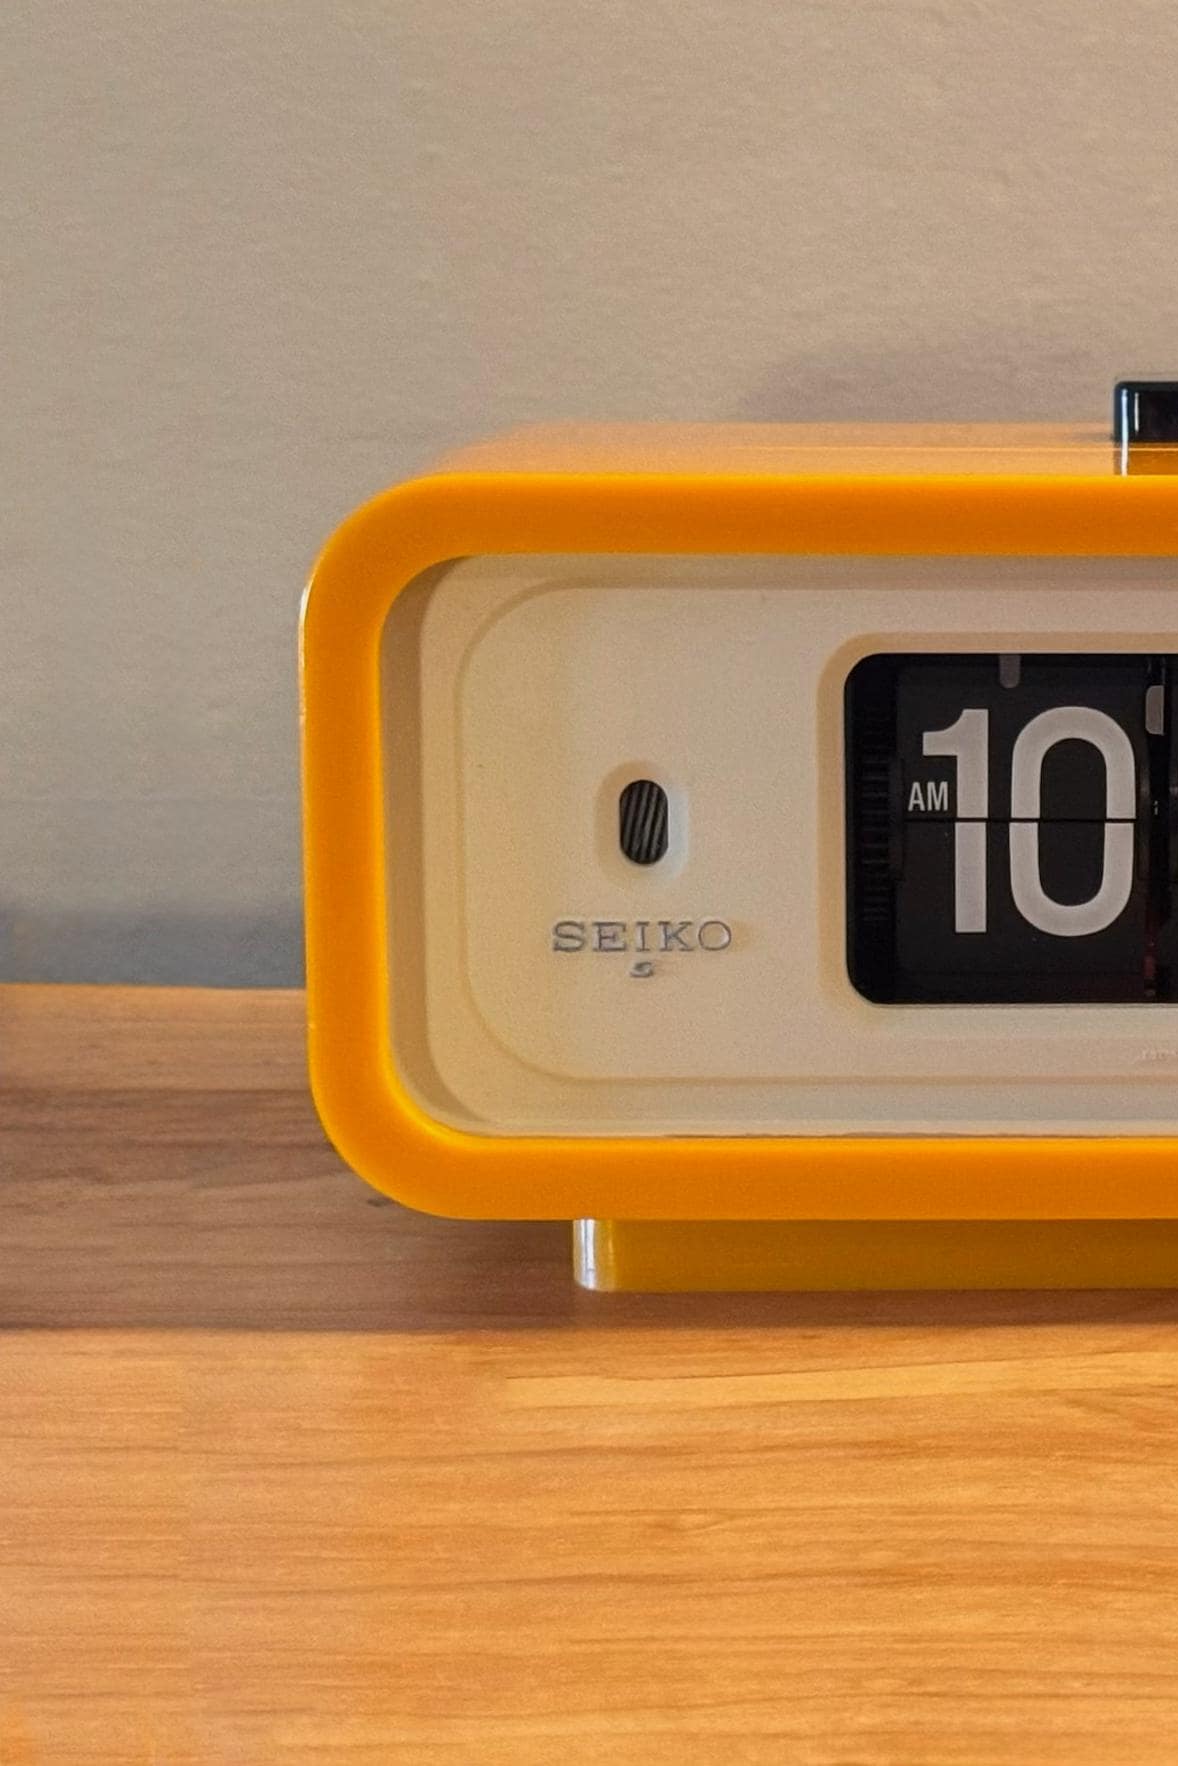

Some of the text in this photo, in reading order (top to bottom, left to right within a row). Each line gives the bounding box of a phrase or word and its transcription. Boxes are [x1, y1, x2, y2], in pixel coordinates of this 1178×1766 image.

[908, 781, 949, 811] AM
[922, 706, 1137, 936] 10
[553, 921, 732, 952] SEIKO
